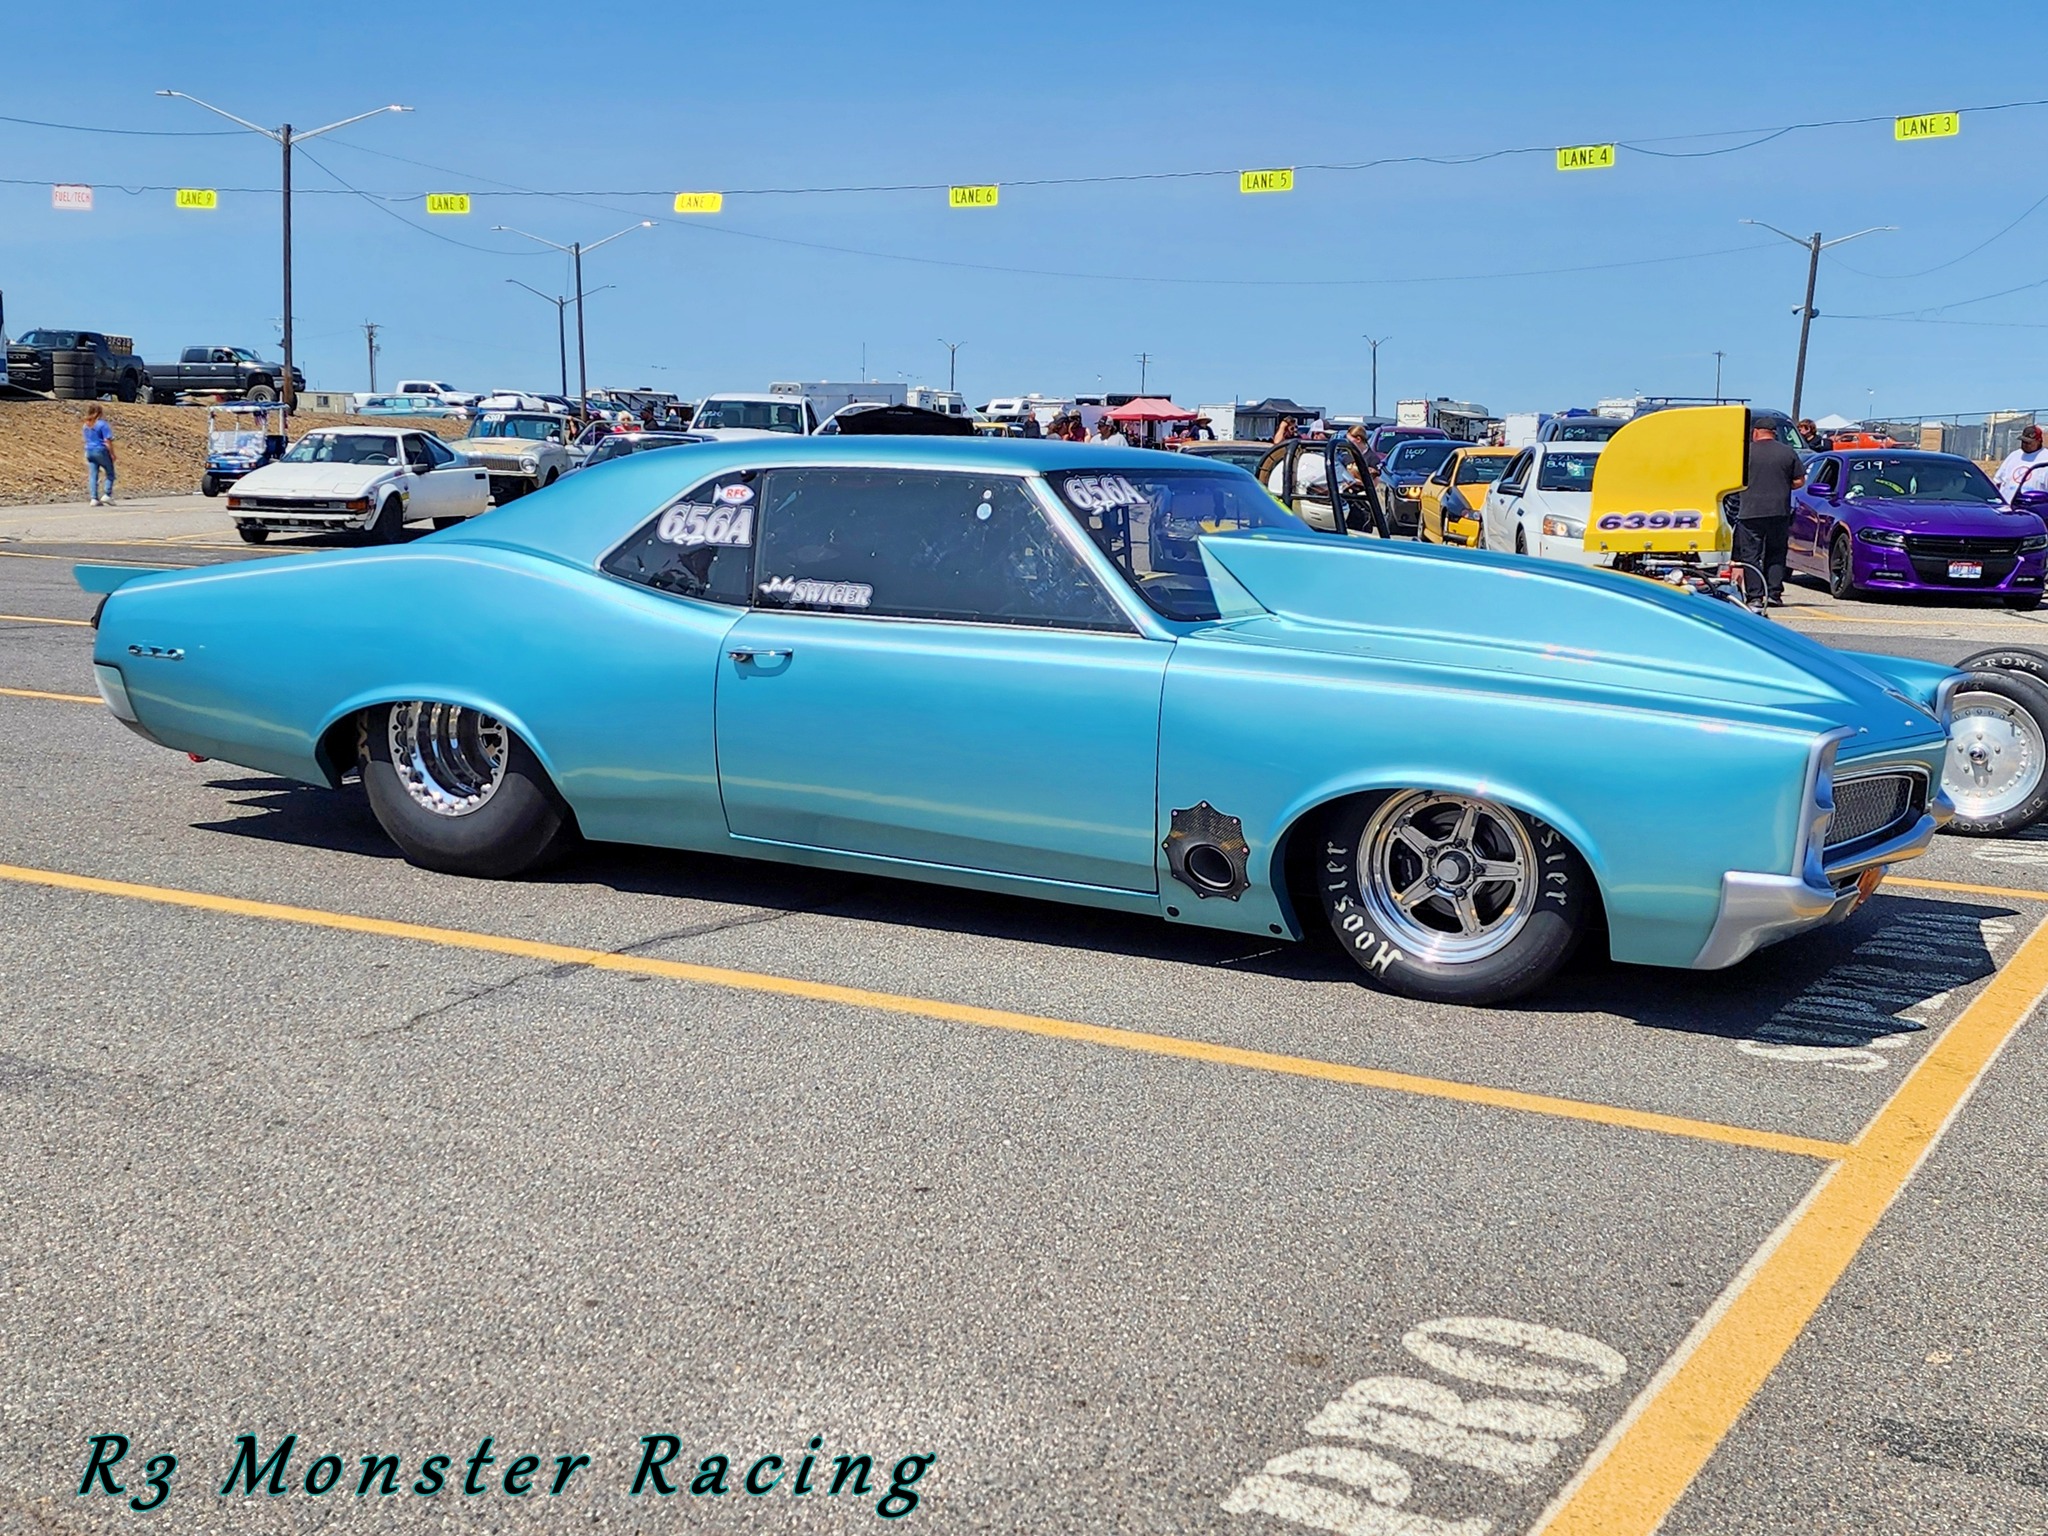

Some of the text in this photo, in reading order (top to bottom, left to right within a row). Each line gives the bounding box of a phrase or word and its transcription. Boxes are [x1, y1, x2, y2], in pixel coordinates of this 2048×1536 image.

[1903, 116, 1951, 137] LANE 3
[1563, 148, 1608, 167] LANE 4
[1246, 172, 1287, 189] LANE 5
[180, 191, 212, 205] LANE 9
[431, 196, 465, 211] LANE 8
[680, 195, 705, 208] LANE
[955, 189, 993, 203] LANE 6
[1853, 461, 1883, 471] 619
[725, 488, 747, 498] RFC
[1065, 475, 1149, 510] 656A
[657, 502, 753, 547] 656A
[1598, 509, 1702, 531] 639R
[790, 579, 873, 607] SWIGER
[1326, 840, 1404, 976] Hoosier
[1219, 1315, 1628, 1536] PRO
